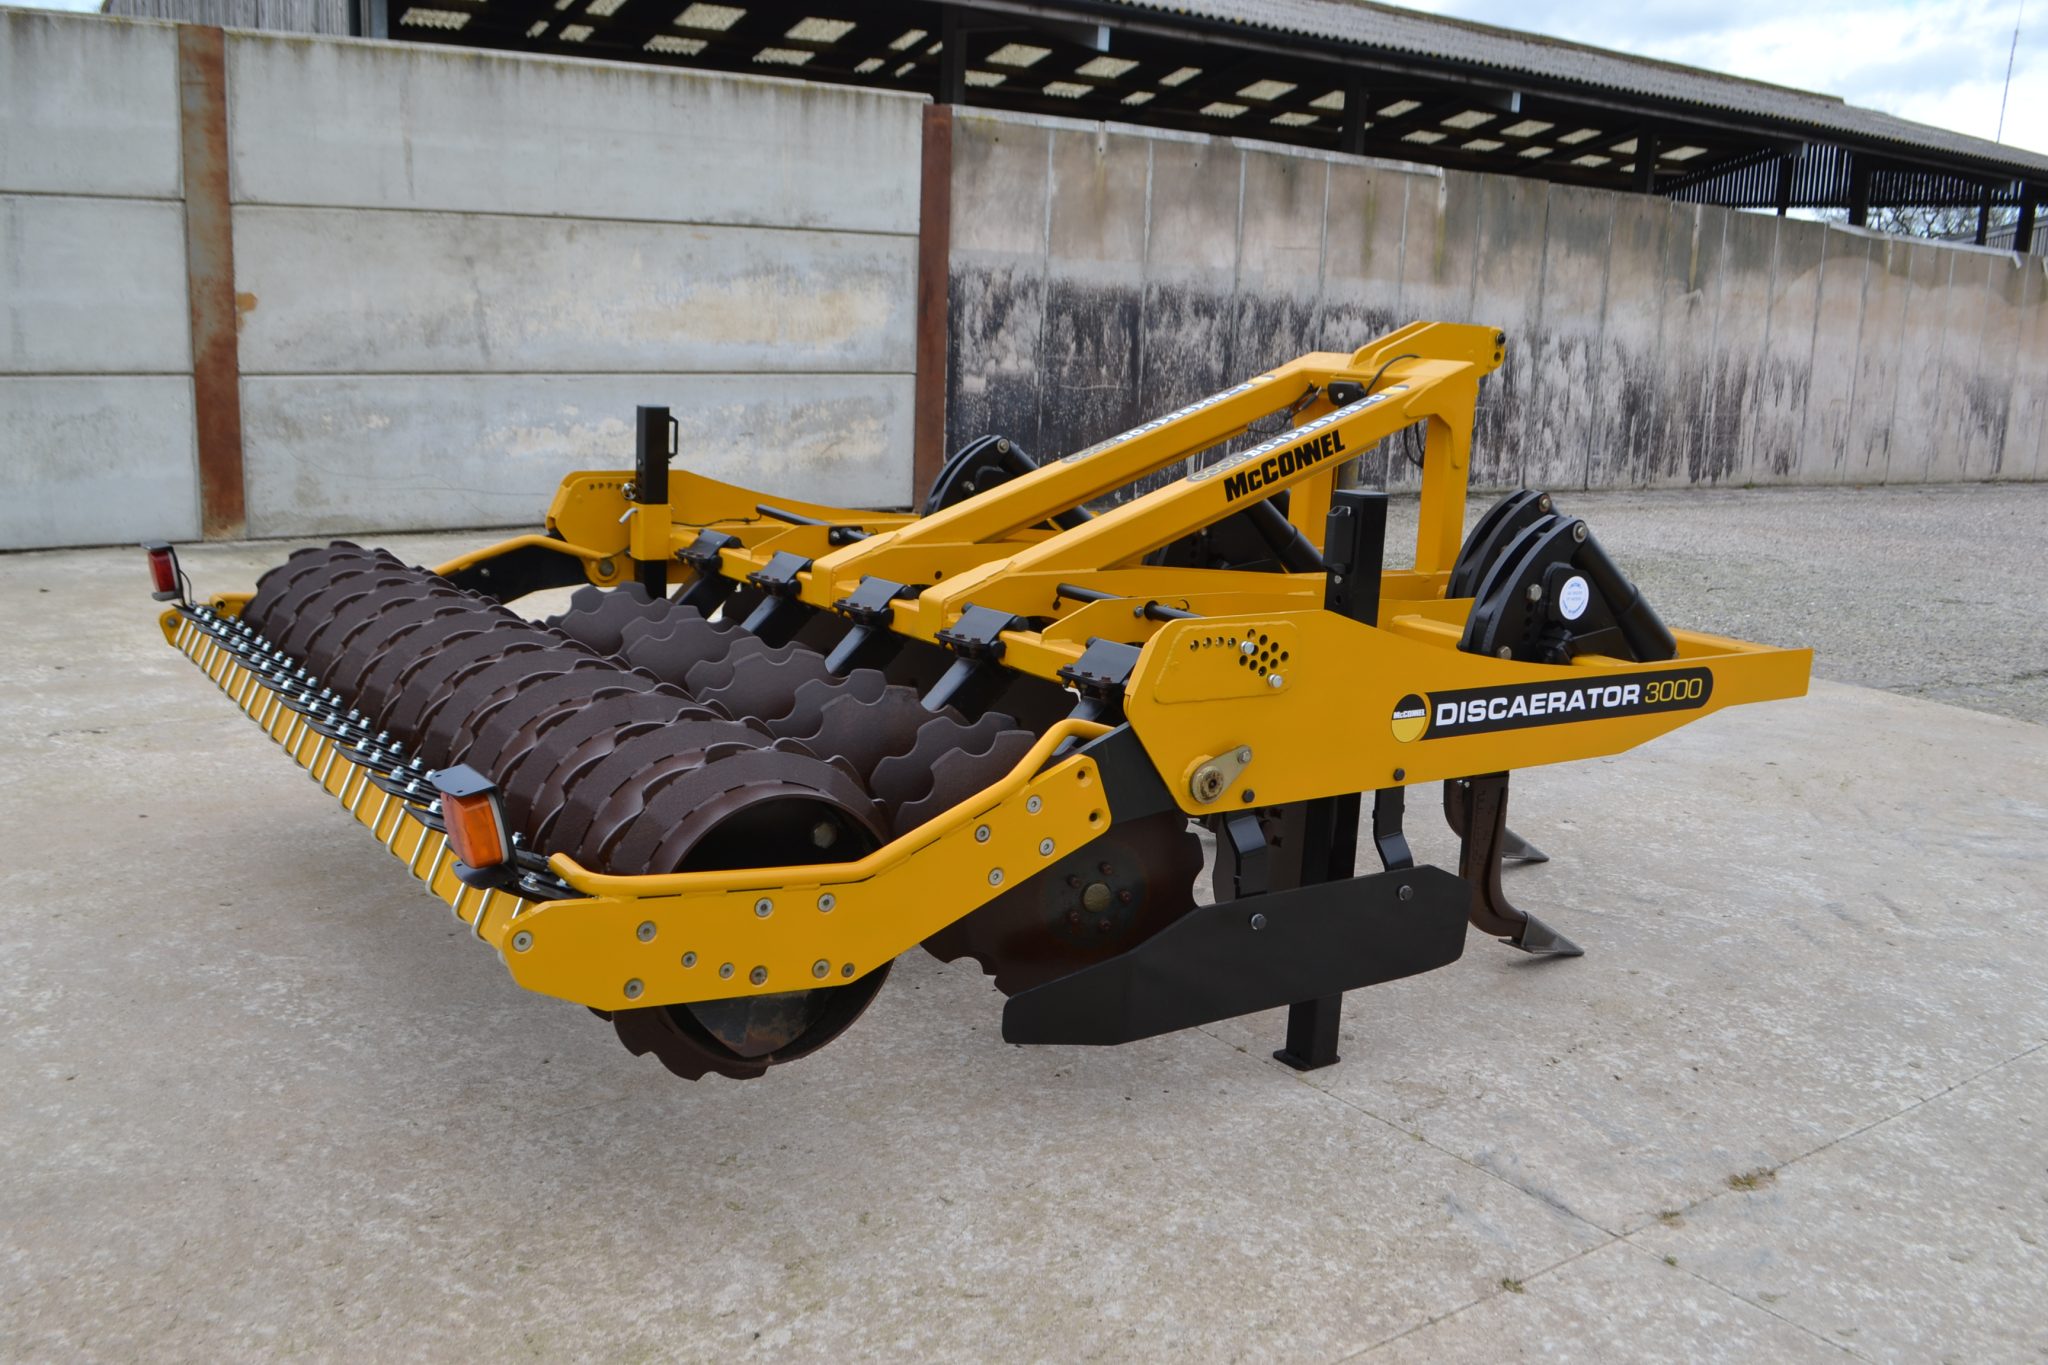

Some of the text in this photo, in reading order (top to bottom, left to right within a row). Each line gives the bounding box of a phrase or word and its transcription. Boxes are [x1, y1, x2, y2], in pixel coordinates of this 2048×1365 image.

[1243, 394, 1387, 457] DISCAERATOR
[1224, 430, 1345, 502] McCONNEL
[1436, 678, 1703, 726] DISCAERATOR 3000
